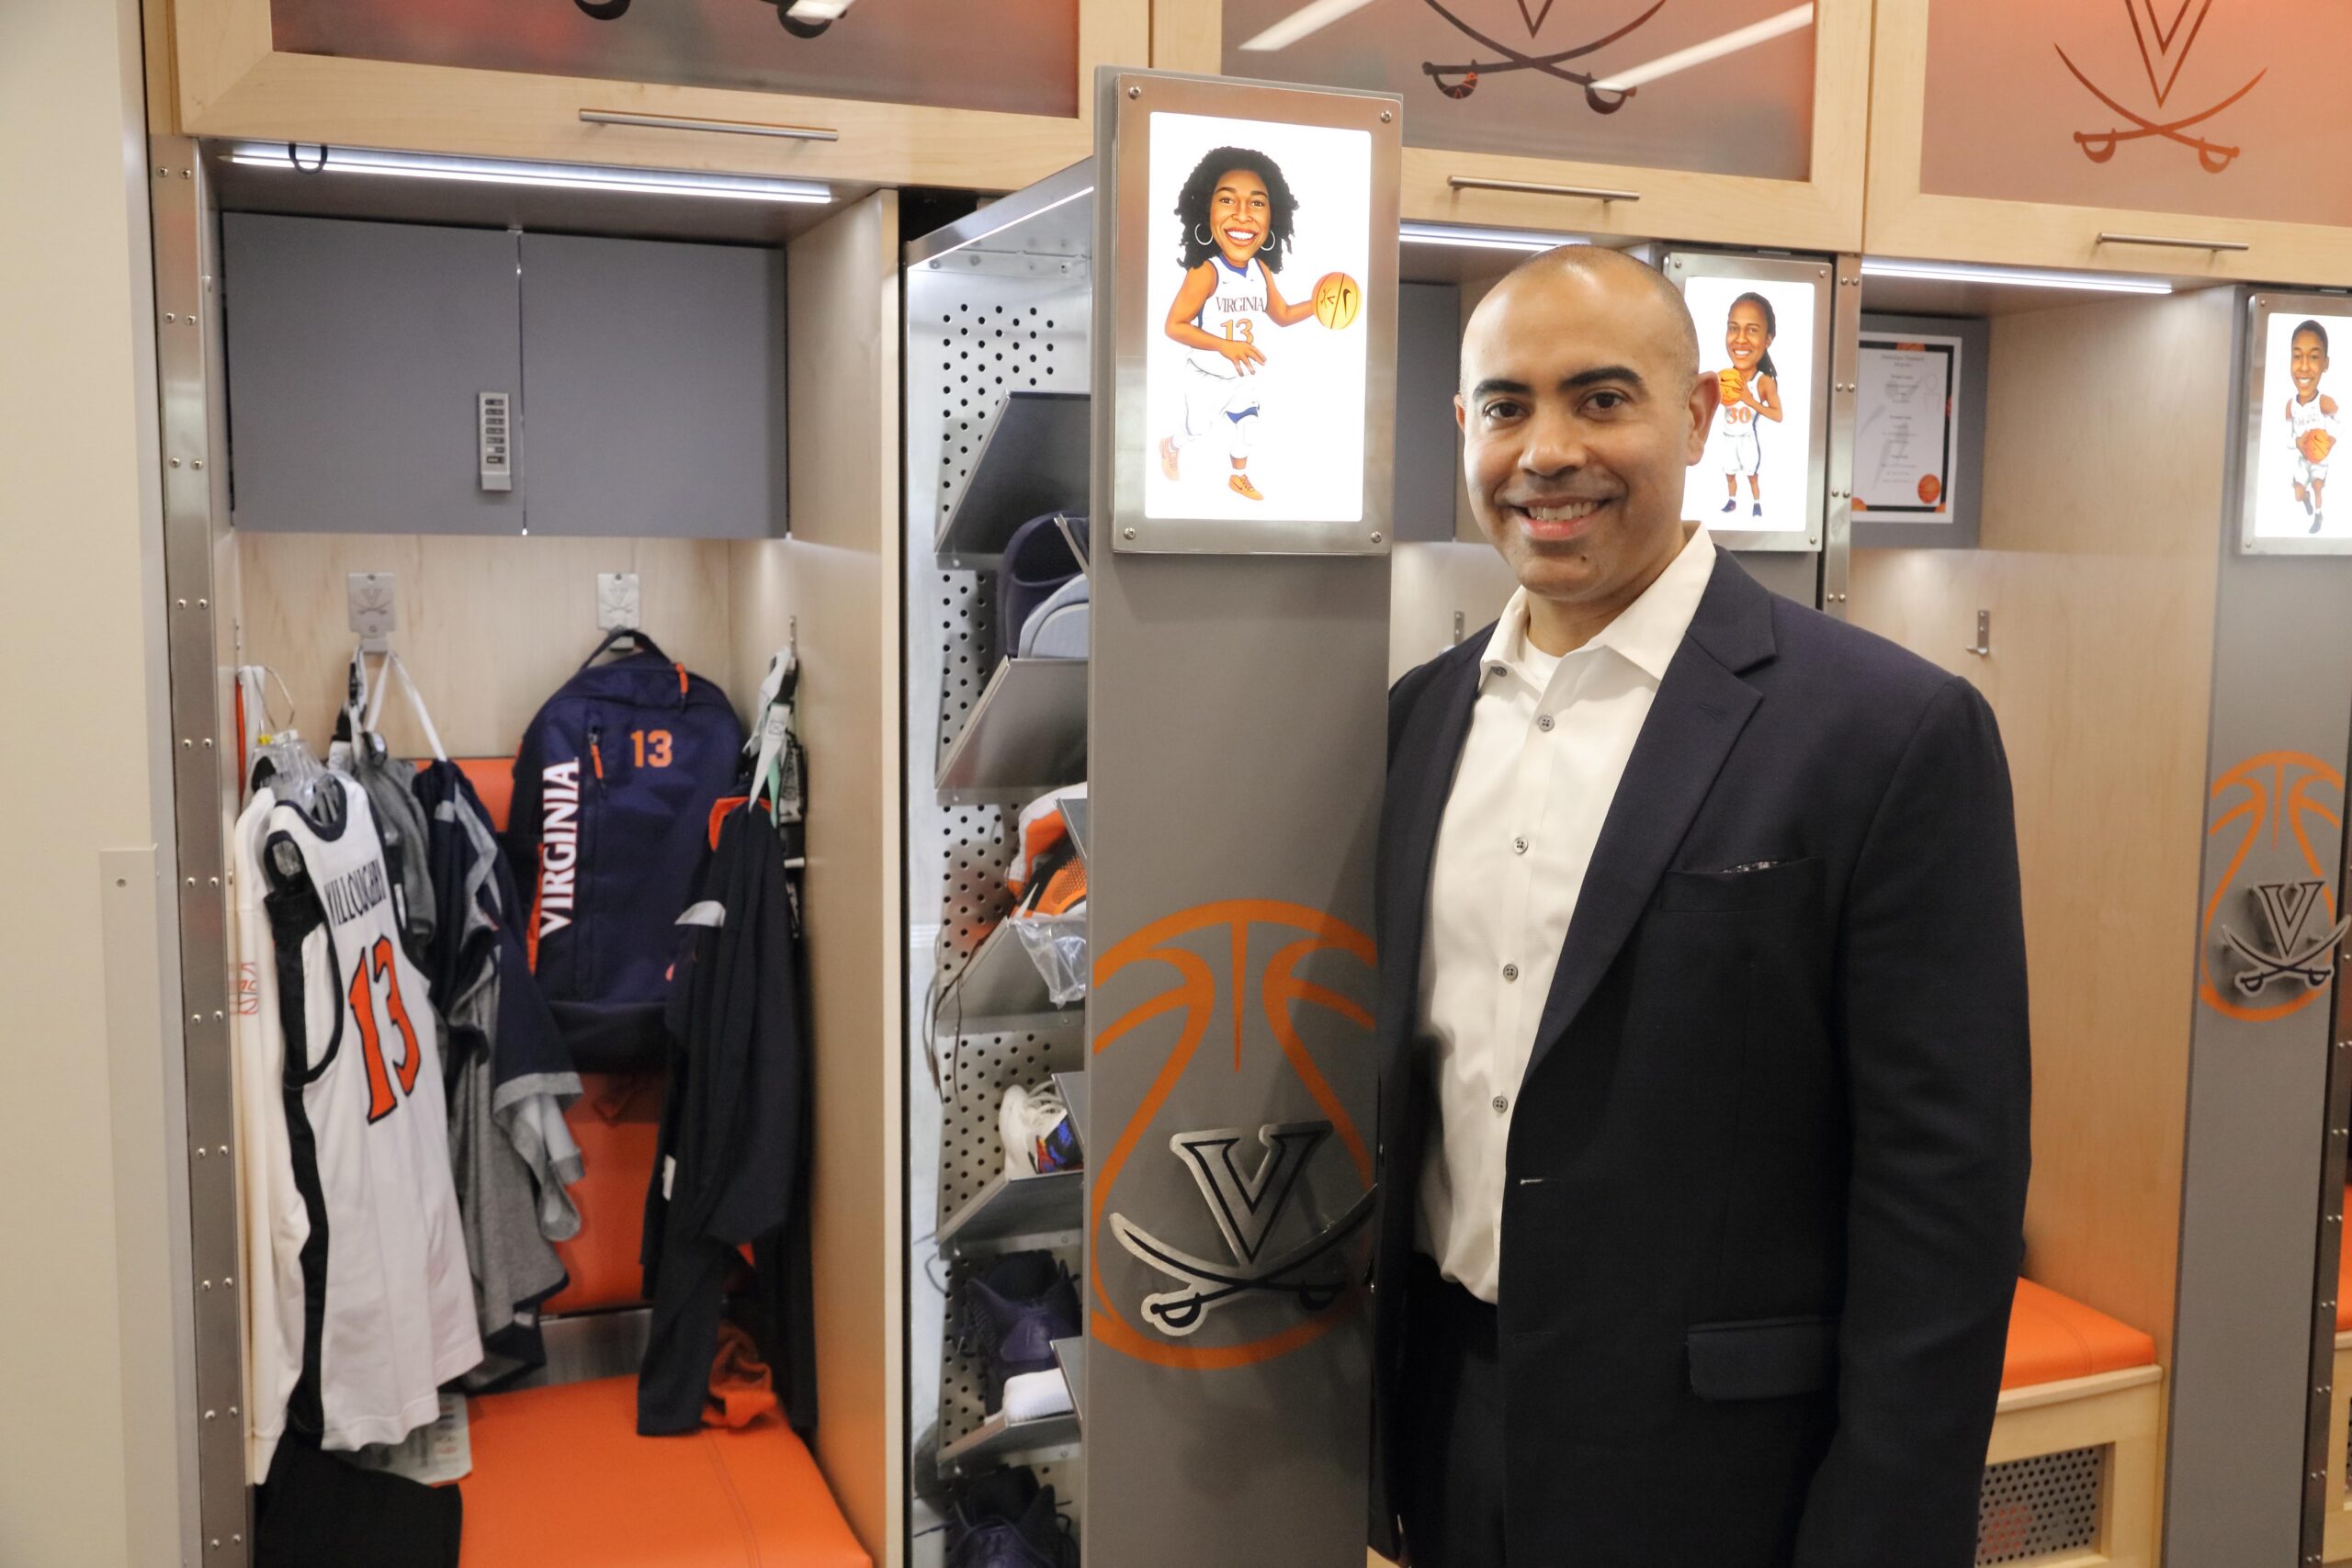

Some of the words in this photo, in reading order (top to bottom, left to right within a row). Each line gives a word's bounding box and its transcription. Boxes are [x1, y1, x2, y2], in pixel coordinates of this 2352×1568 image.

[1216, 296, 1266, 313] VIRGINIA
[1220, 318, 1254, 345] 13
[1724, 406, 1751, 424] 30
[630, 729, 673, 769] 13
[539, 760, 580, 940] VIRGINIA
[2257, 880, 2326, 958] V
[348, 933, 422, 1125] 13
[1175, 1124, 1334, 1266] V
